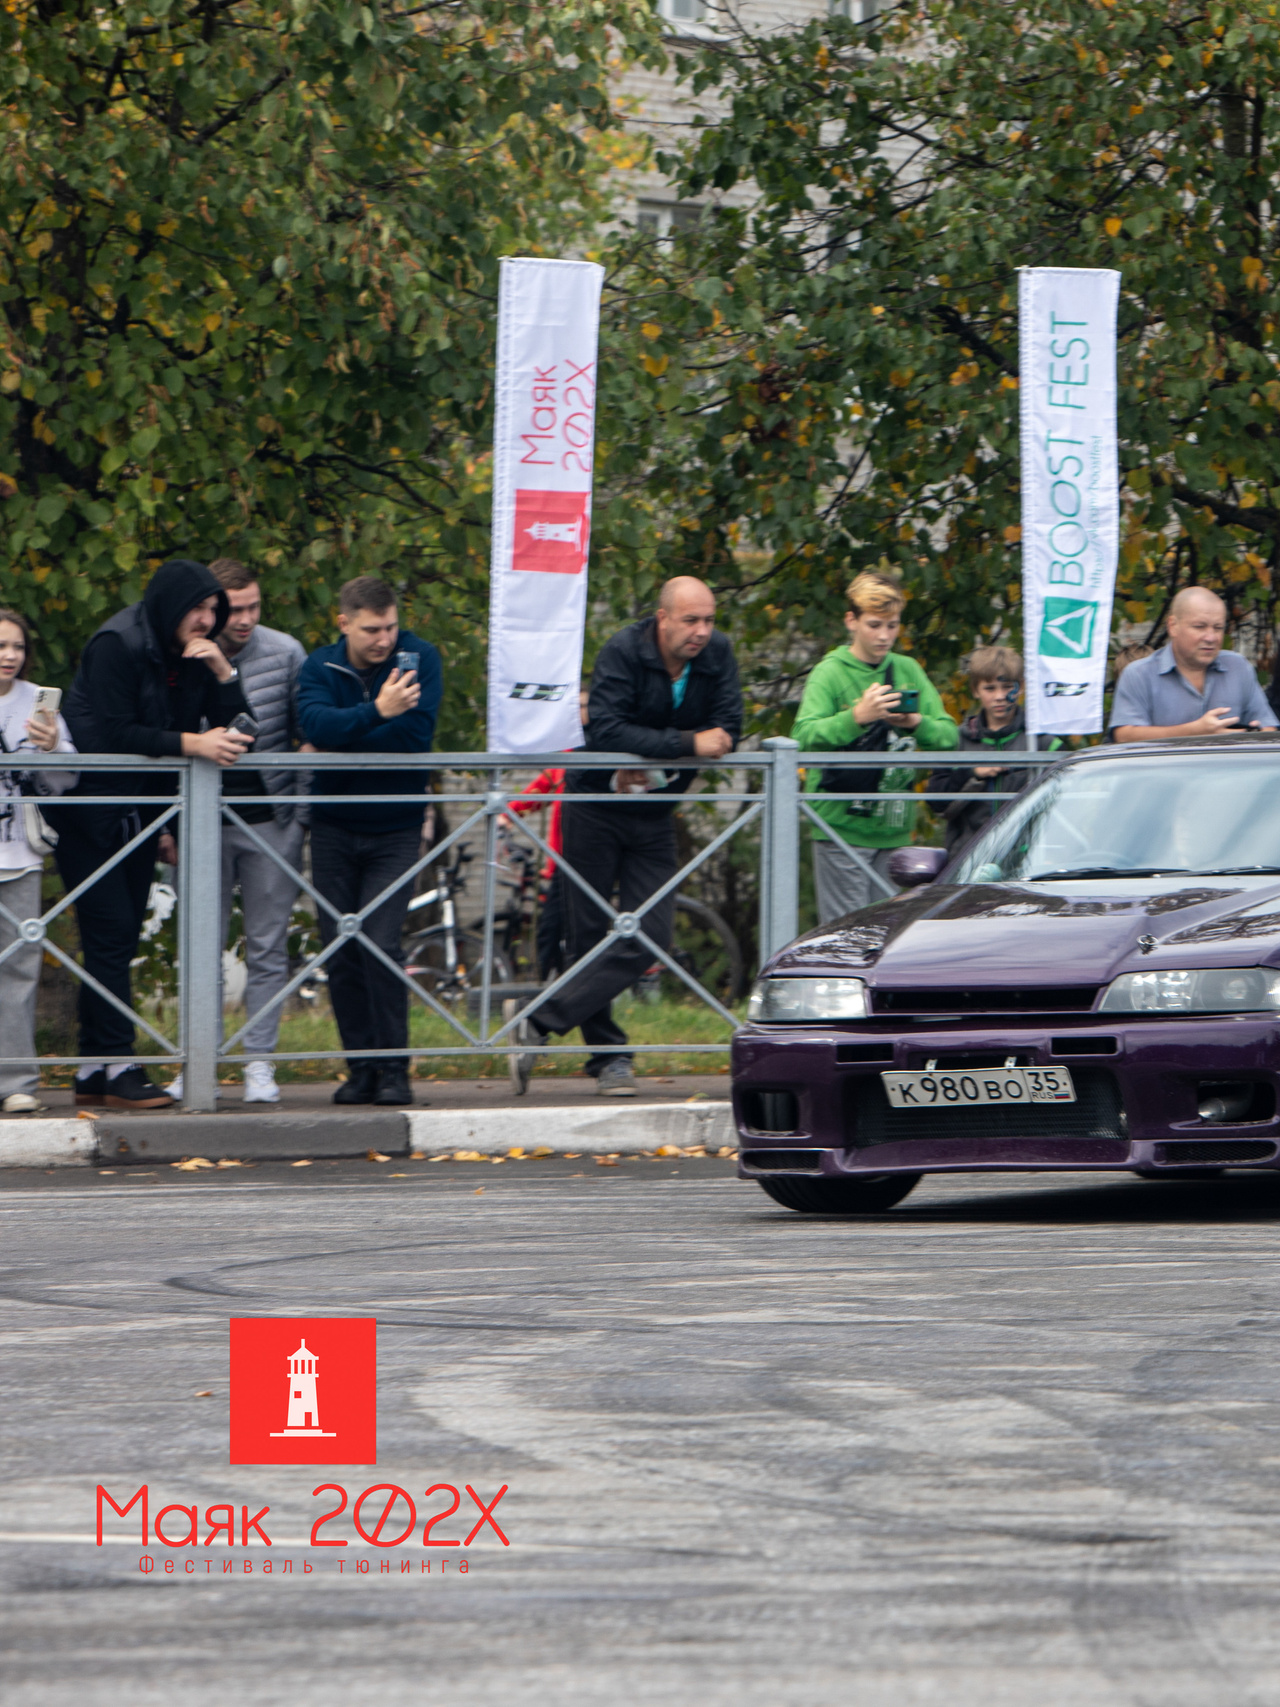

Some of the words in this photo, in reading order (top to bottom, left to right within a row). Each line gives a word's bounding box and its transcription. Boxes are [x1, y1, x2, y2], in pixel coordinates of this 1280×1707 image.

[1048, 310, 1090, 409] FEST
[519, 364, 558, 464] Маяк
[1044, 429, 1089, 586] BOOST
[1027, 1072, 1060, 1091] 35
[1032, 1091, 1053, 1099] RUS
